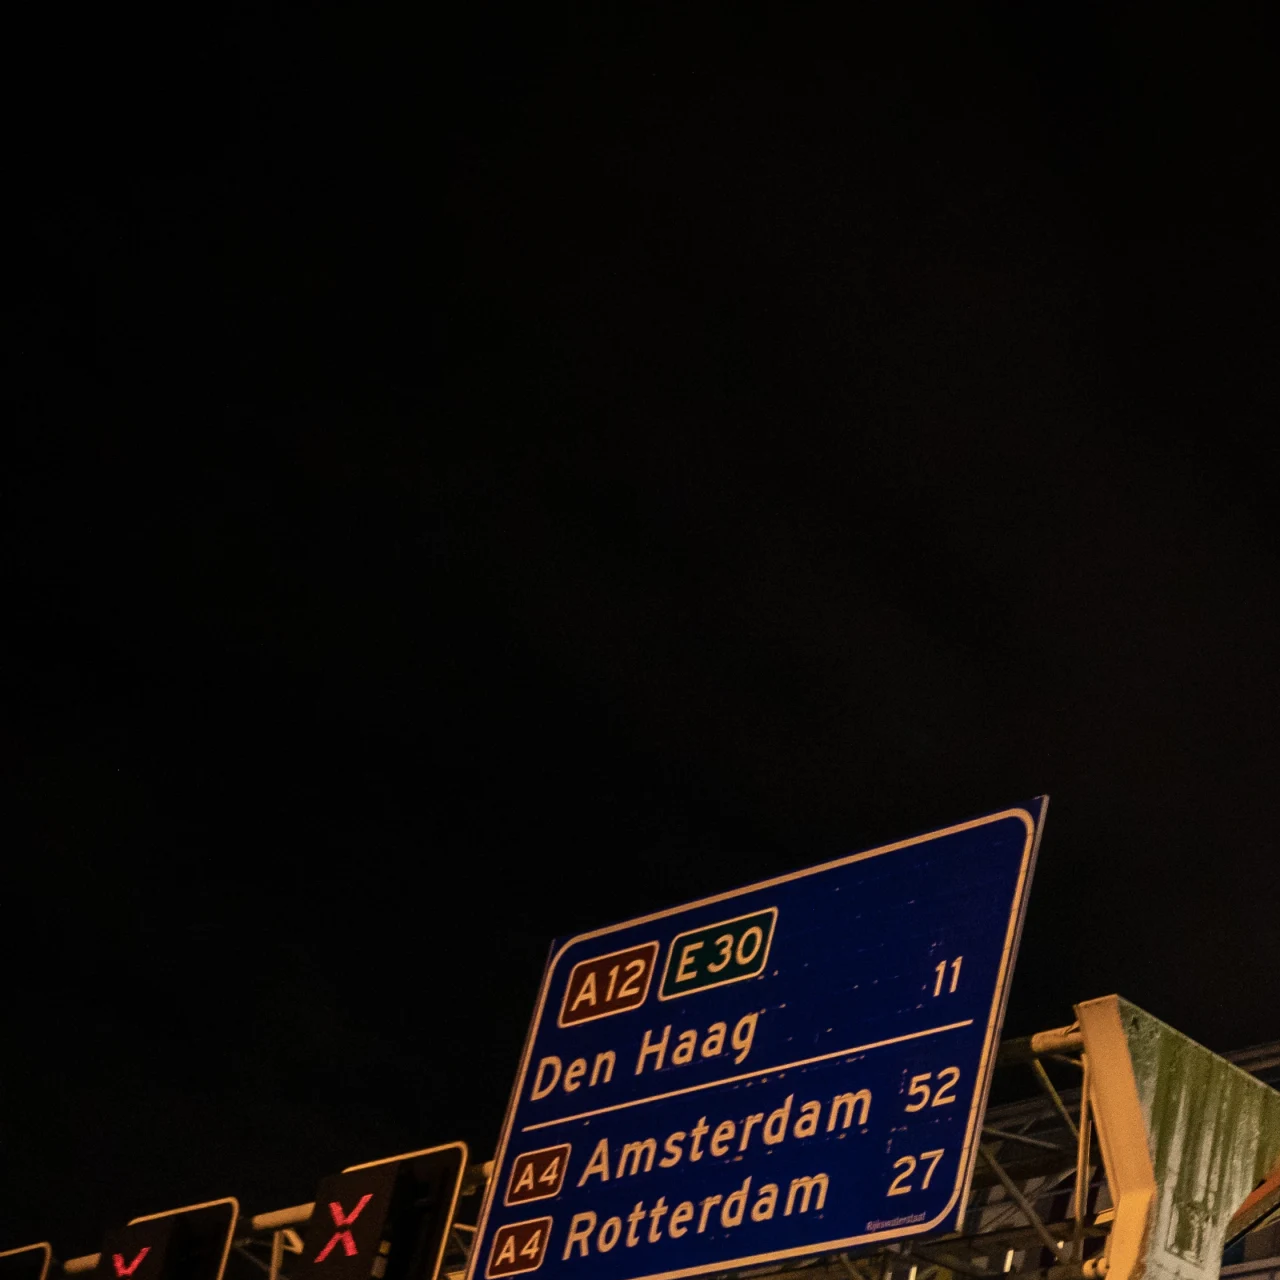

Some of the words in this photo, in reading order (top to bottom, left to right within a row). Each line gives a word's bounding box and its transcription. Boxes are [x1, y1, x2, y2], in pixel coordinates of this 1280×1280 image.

[531, 1050, 616, 1101] Den
[635, 1012, 759, 1075] Haag
[932, 956, 963, 997] 11
[569, 959, 646, 1012] A12
[675, 926, 763, 983] E30
[513, 1157, 559, 1194] A4
[577, 1088, 872, 1188] Amsterdam
[905, 1066, 960, 1113] 52
[494, 1230, 541, 1266] A4
[562, 1172, 830, 1261] Rotterdam
[886, 1148, 944, 1197] 27
